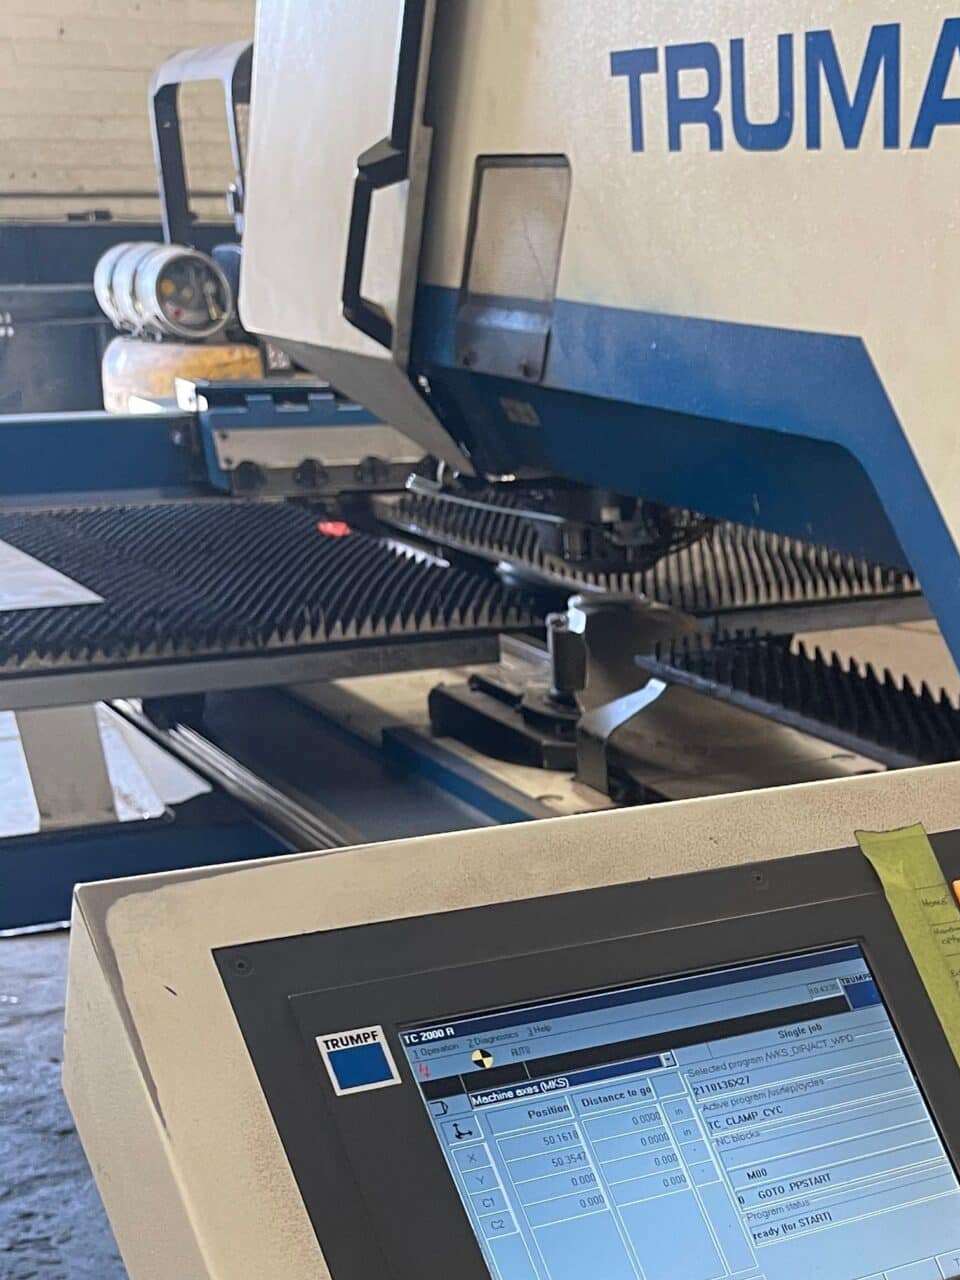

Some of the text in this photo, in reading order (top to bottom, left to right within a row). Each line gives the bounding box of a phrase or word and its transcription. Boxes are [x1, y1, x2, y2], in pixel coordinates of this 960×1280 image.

[323, 1030, 379, 1051] TRUMPF
[403, 1026, 455, 1045] TC 2000 R
[778, 1023, 823, 1041] Single job
[687, 1062, 727, 1077] Selected
[728, 1055, 764, 1071] program
[473, 1077, 570, 1106] Machine axes (MKS)
[581, 1086, 652, 1108] Distance to go
[528, 1103, 571, 1120] Position
[702, 1100, 729, 1113] Active
[730, 1092, 767, 1108] program
[715, 1129, 761, 1147] NC blocks
[467, 1153, 478, 1164] X
[475, 1175, 486, 1186] Y
[758, 1185, 785, 1200] GOTO
[482, 1197, 496, 1209] C1
[746, 1199, 811, 1220] Program status
[490, 1220, 505, 1231] C2
[752, 1226, 780, 1241] ready
[798, 1211, 833, 1229] START)
